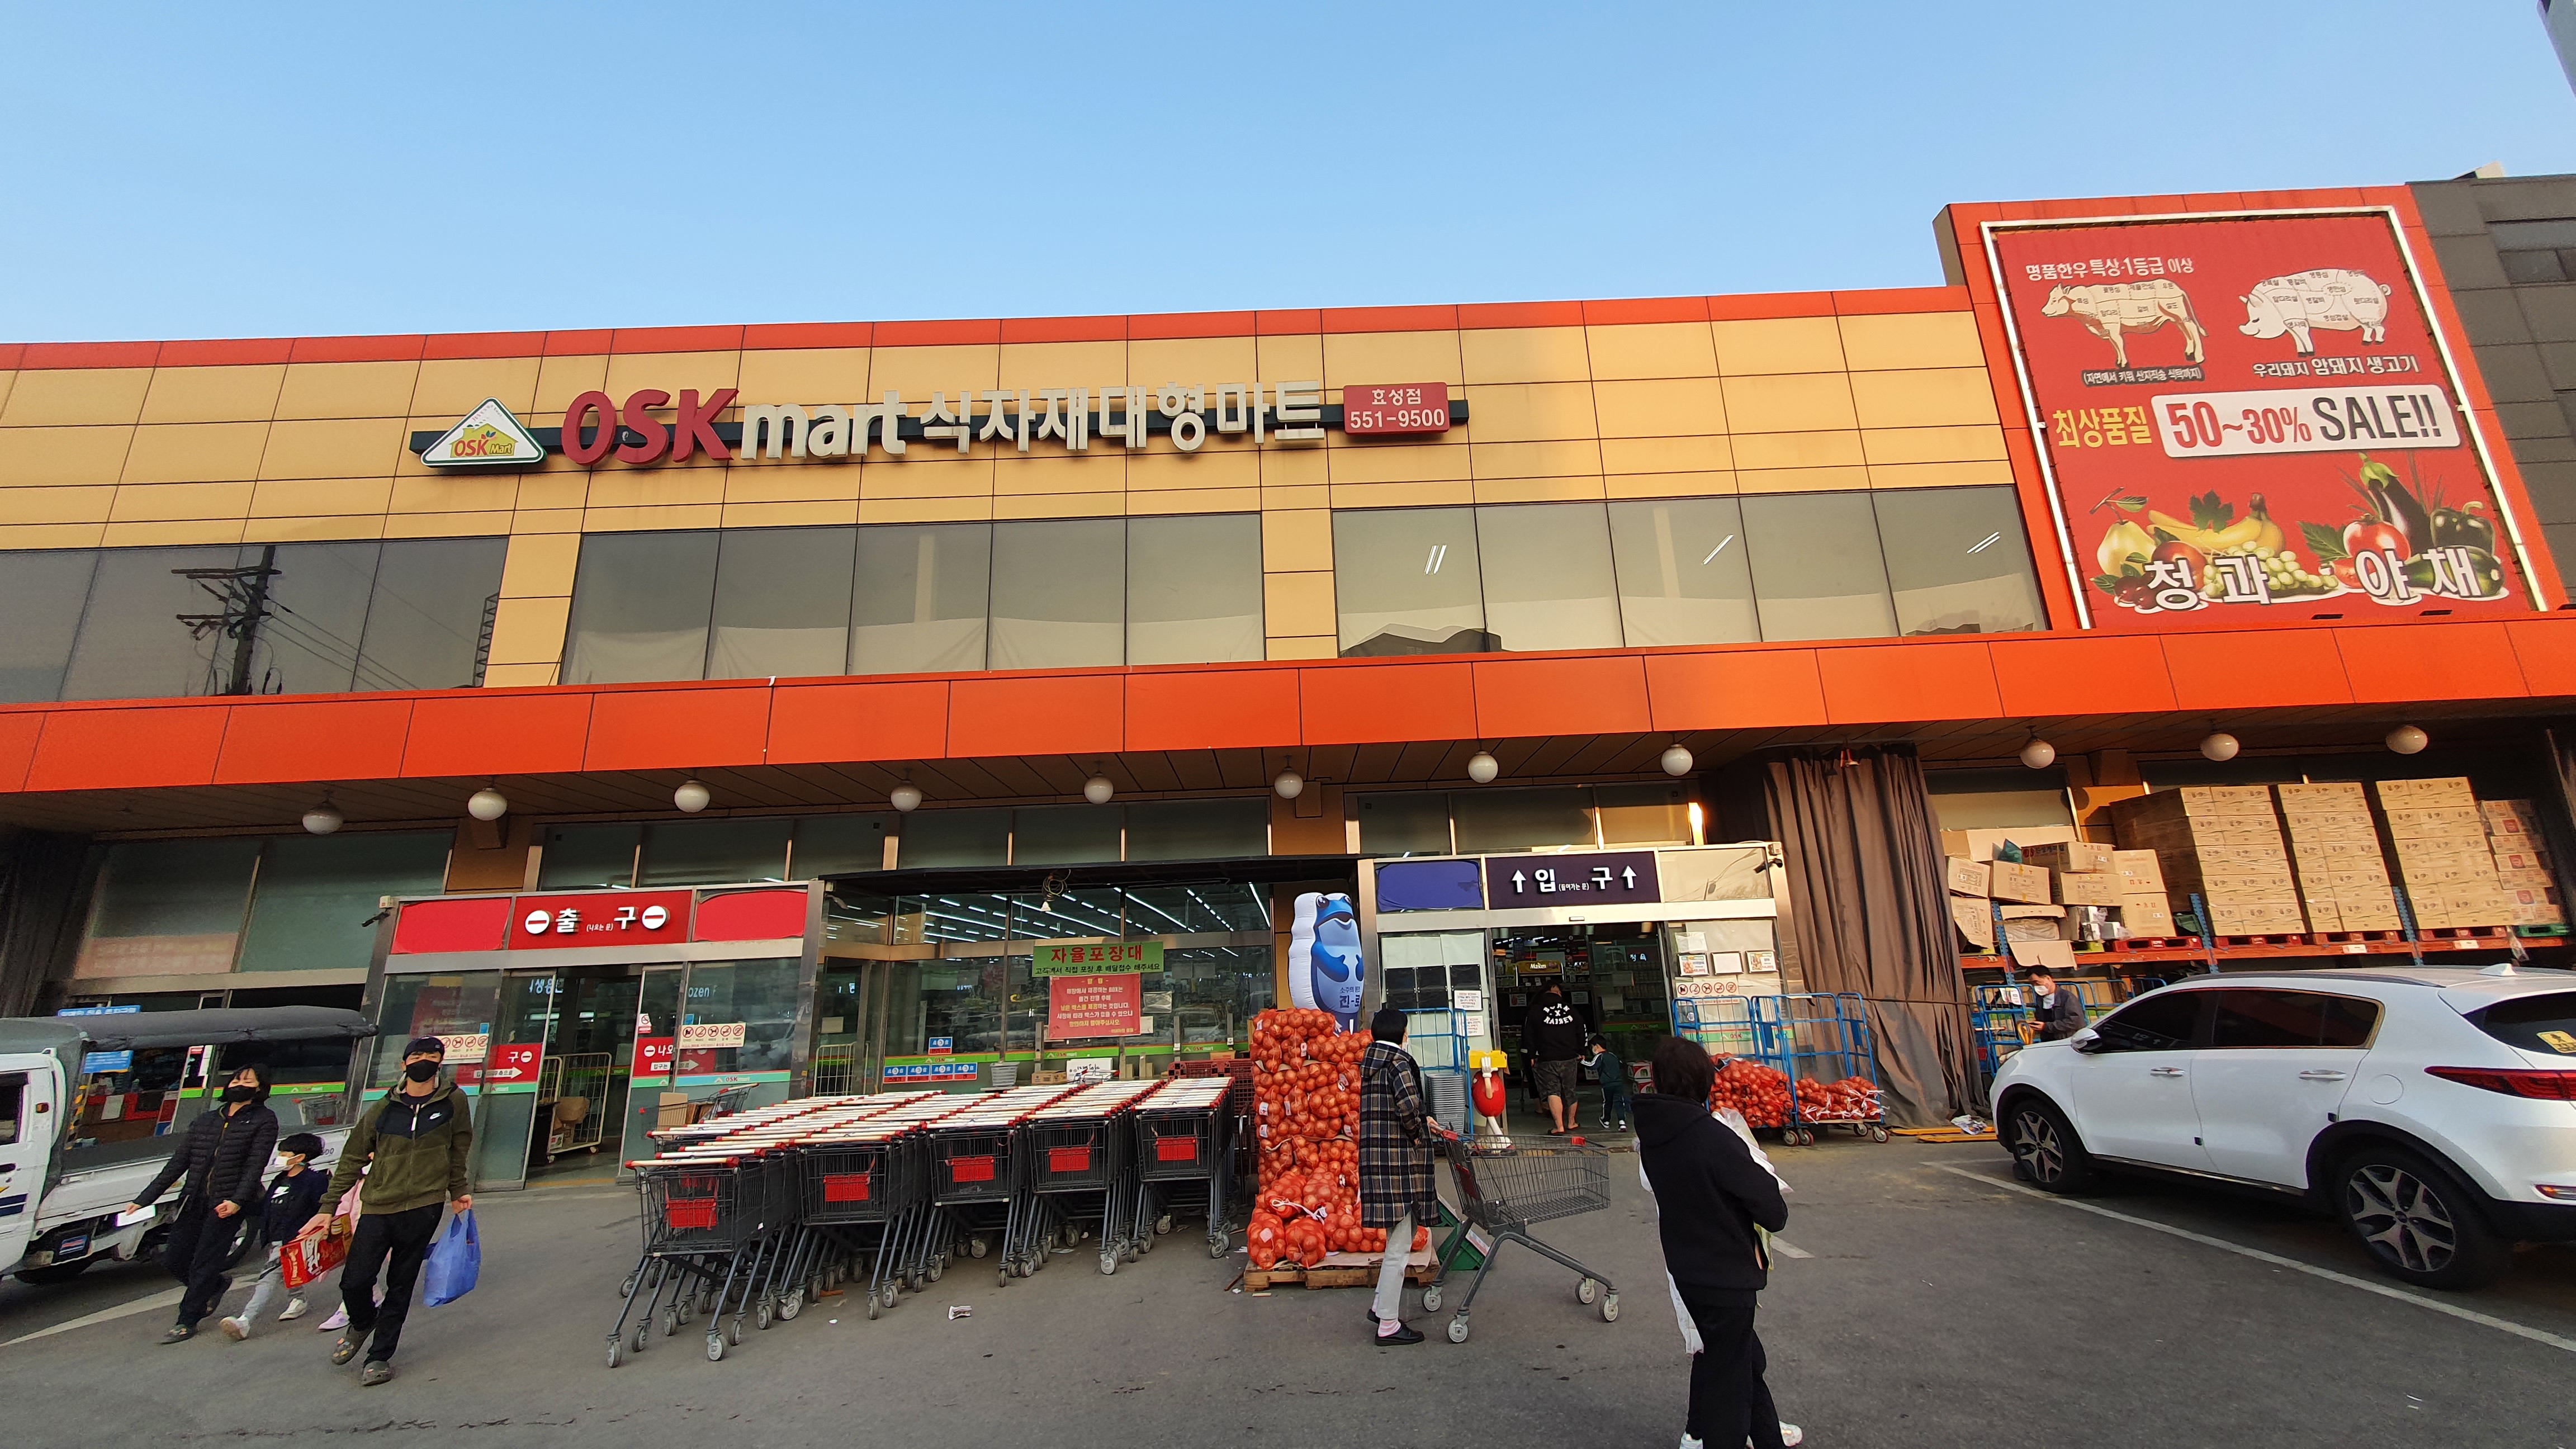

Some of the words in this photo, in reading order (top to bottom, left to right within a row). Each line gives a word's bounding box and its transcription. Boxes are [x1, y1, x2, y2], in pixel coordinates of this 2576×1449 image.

[2025, 262, 2088, 281] 명품한우
[2167, 258, 2194, 274] 이상
[2252, 362, 2310, 377] 우리돼지
[2312, 357, 2365, 376] 암돼지
[2366, 356, 2419, 374] 생고기
[1371, 388, 1422, 406] 효성점
[1349, 409, 1445, 429] 551-9500
[2052, 405, 2152, 448] 최상품질
[2165, 400, 2312, 448] 50~30%
[2312, 394, 2442, 441] SALE!!
[454, 439, 490, 456] OSK
[489, 443, 513, 454] Mart
[688, 987, 710, 998] ozen
